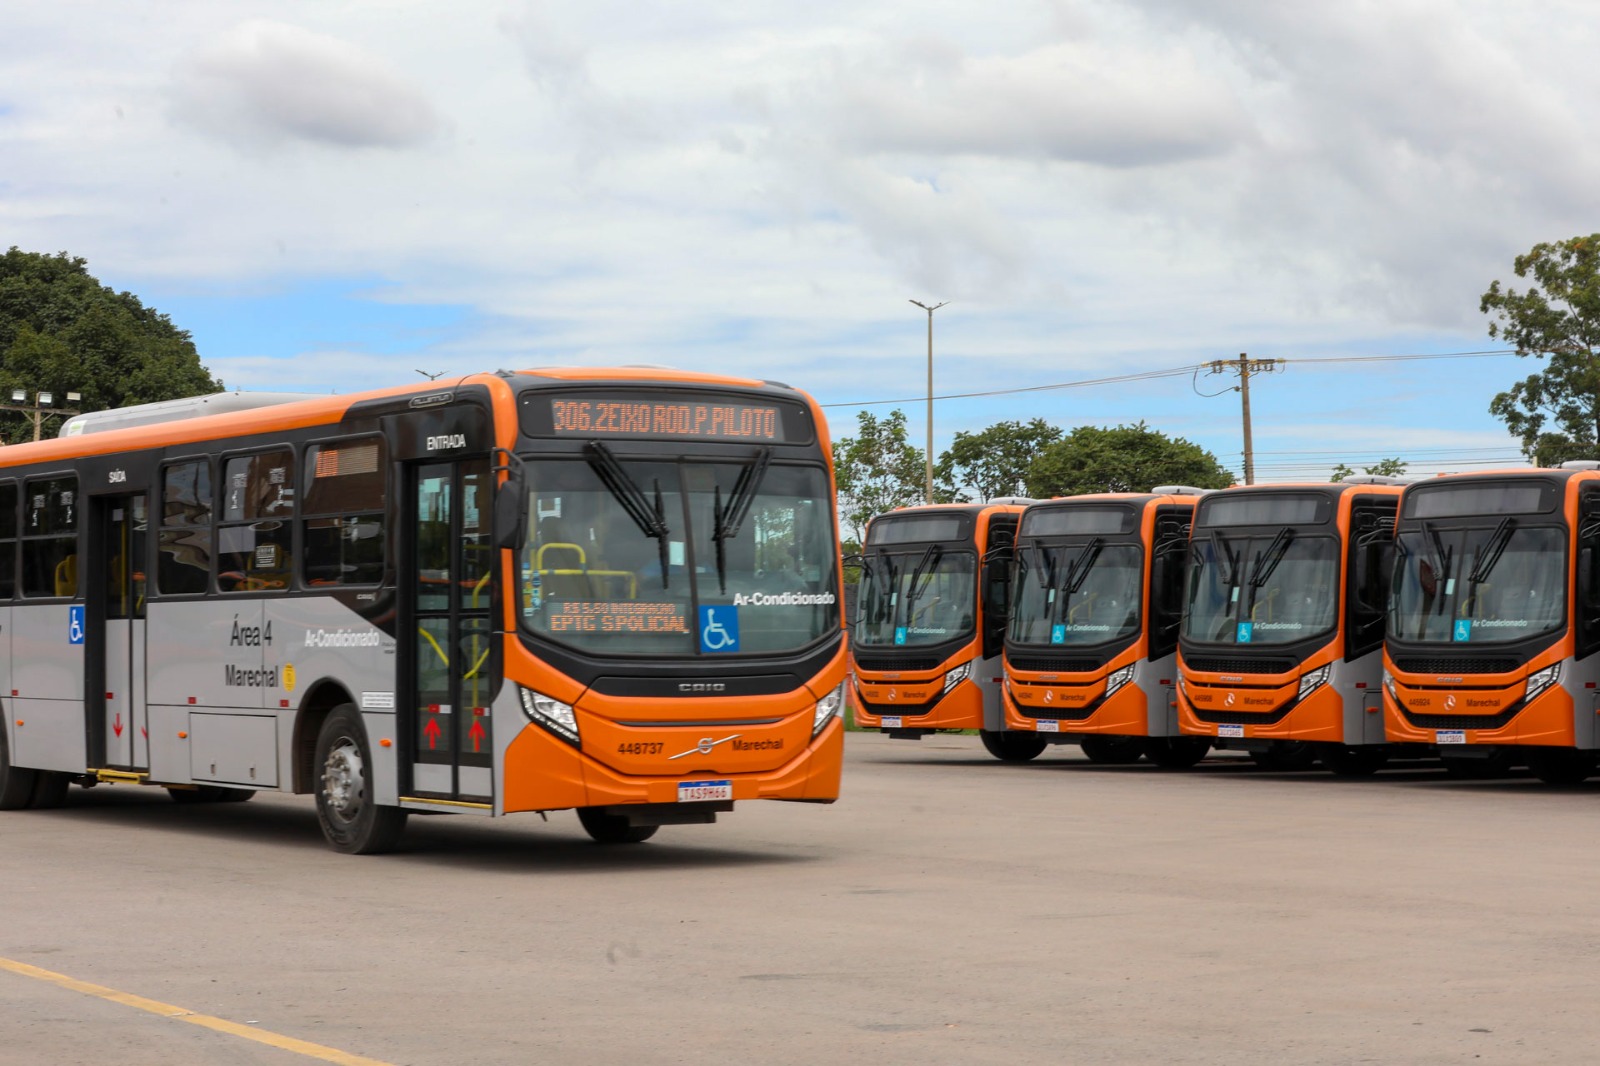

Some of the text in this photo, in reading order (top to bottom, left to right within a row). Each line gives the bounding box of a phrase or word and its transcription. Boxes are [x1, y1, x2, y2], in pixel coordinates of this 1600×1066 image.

[427, 434, 466, 450] ENTRADA
[109, 468, 126, 483] SAÍDA
[733, 591, 835, 606] Ar-Condicionado
[551, 615, 596, 631] EPTG
[1261, 622, 1302, 630] Condicionado
[1472, 619, 1528, 628] Ar Condicionado
[230, 613, 272, 647] Área 4
[913, 626, 946, 634] Condicionado
[305, 628, 379, 647] Ar-Condicionado
[225, 664, 279, 688] Marechal
[678, 683, 725, 692] CAIO
[1244, 697, 1274, 705] Marechal
[1466, 699, 1500, 707] Marechal
[618, 742, 664, 755] 448737
[732, 738, 784, 751] Marechal
